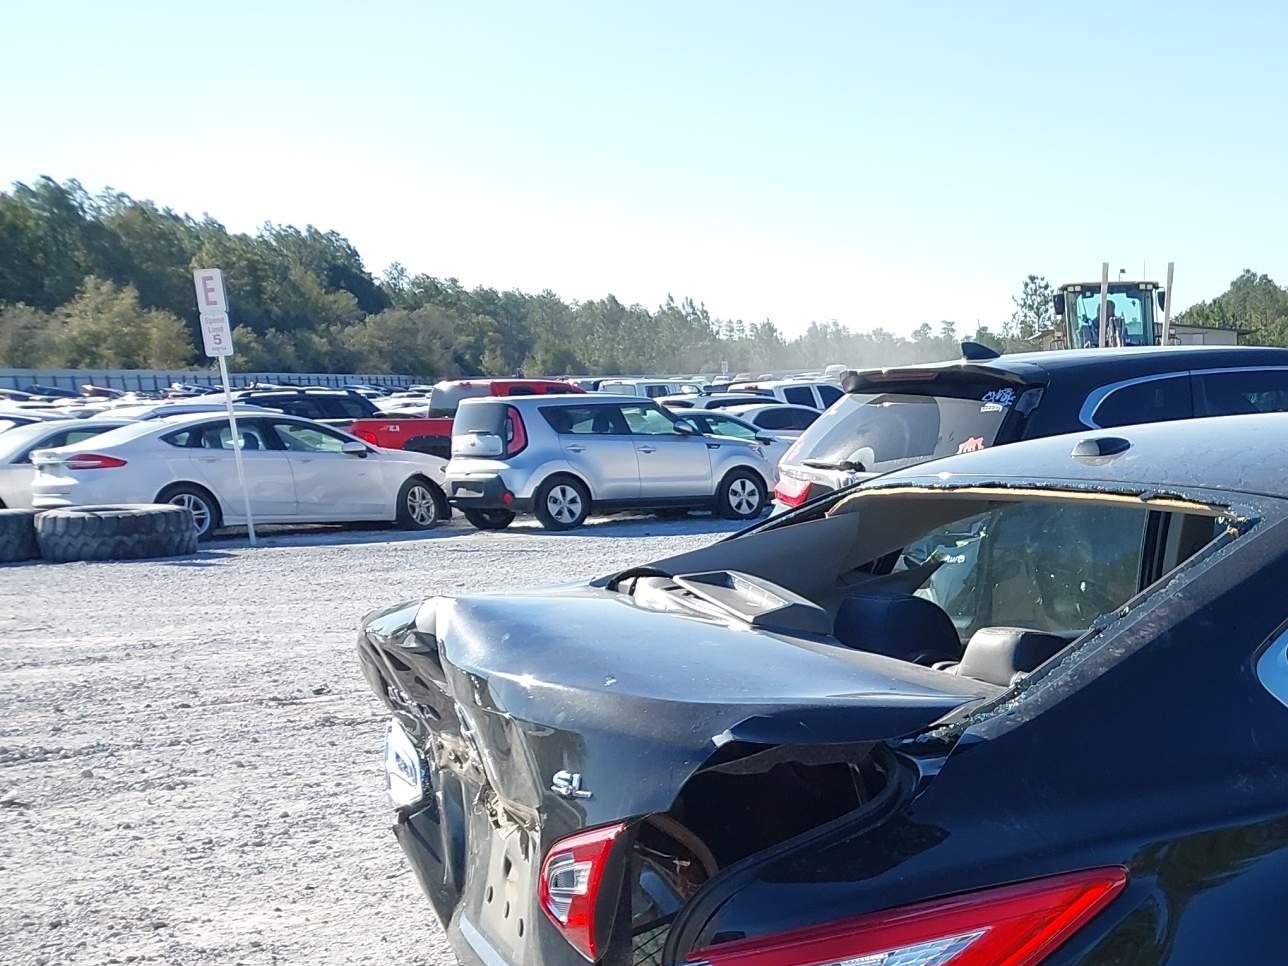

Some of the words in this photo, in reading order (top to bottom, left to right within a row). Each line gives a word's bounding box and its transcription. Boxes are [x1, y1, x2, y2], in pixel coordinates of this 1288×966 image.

[202, 276, 218, 306] E
[213, 334, 223, 345] 5
[550, 769, 593, 798] SL
